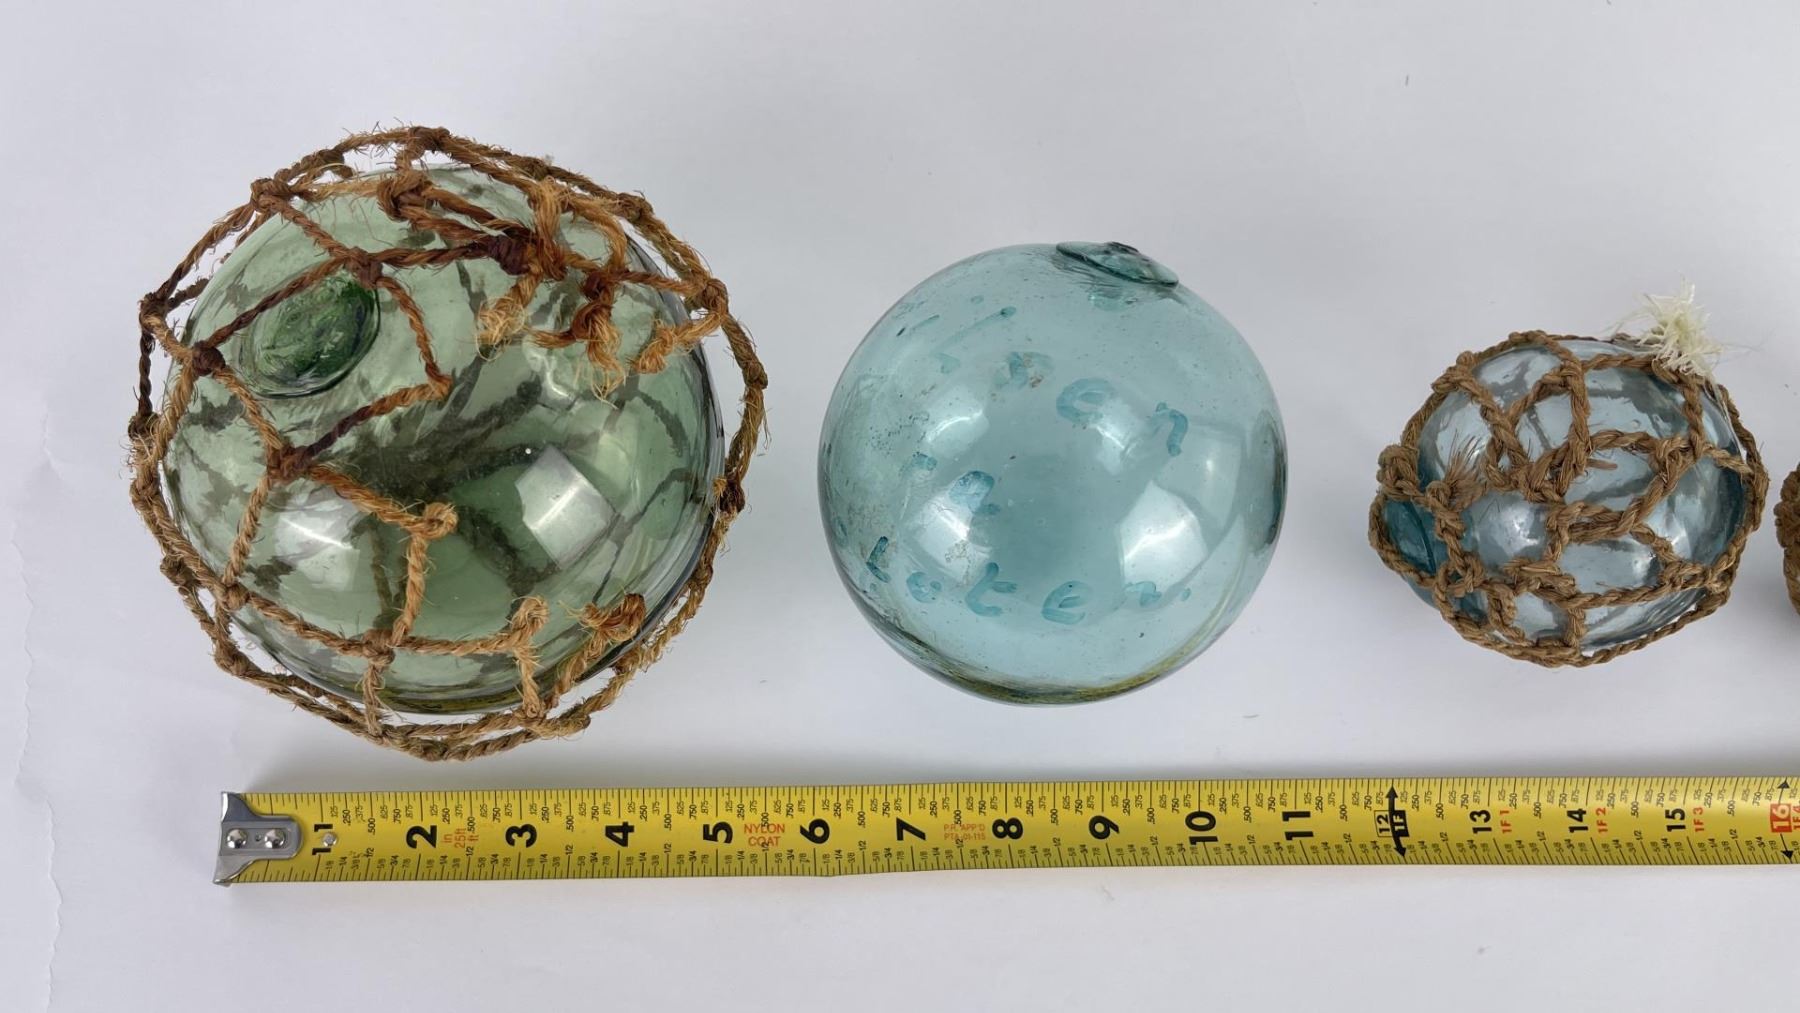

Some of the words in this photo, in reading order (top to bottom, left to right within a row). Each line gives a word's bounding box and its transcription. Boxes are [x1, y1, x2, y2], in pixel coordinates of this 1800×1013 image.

[1470, 810, 1492, 834] 13
[1567, 809, 1588, 833] 14
[1665, 809, 1686, 832] 15
[1693, 807, 1703, 815] 3
[1772, 805, 1790, 830] 16
[505, 824, 537, 848] 3
[605, 822, 635, 847] 4
[703, 822, 733, 843] 5
[744, 824, 785, 834] NYLON
[800, 819, 830, 844] 6
[896, 817, 926, 841] 7
[992, 817, 1023, 839] 8
[1089, 815, 1120, 839] 9
[1185, 811, 1218, 845] 10
[1282, 811, 1314, 841] 11
[1377, 815, 1390, 833] 12
[1501, 821, 1512, 834] 1F
[1597, 820, 1608, 833] 1F
[1694, 819, 1704, 832] 1F
[406, 825, 437, 849] 2
[748, 836, 781, 847] COAT
